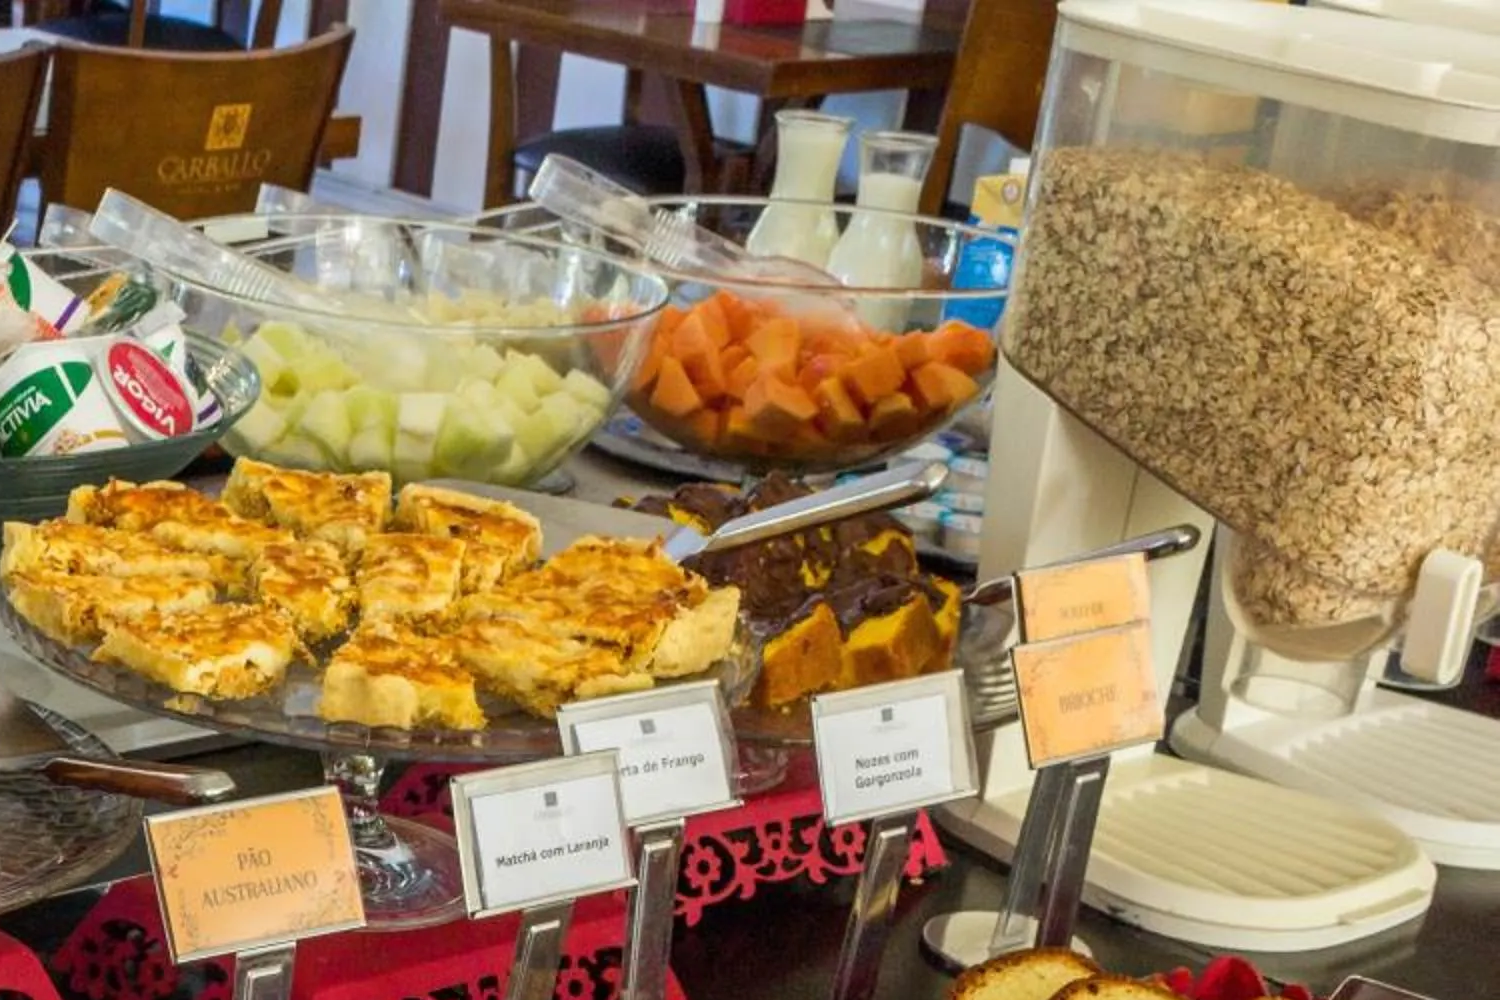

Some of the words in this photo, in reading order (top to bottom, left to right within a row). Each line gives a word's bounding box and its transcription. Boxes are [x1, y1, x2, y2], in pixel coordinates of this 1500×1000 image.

[113, 364, 176, 436] VIGOR
[620, 765, 638, 778] rta
[643, 760, 659, 774] de
[661, 753, 705, 769] Frango
[855, 754, 891, 770] Nozes
[893, 749, 919, 762] com
[855, 767, 922, 789] Gorgonzola
[236, 847, 272, 870] PÃO
[540, 846, 565, 860] com
[567, 836, 610, 855] Laranja
[202, 870, 318, 909] AUSTRALIANO
